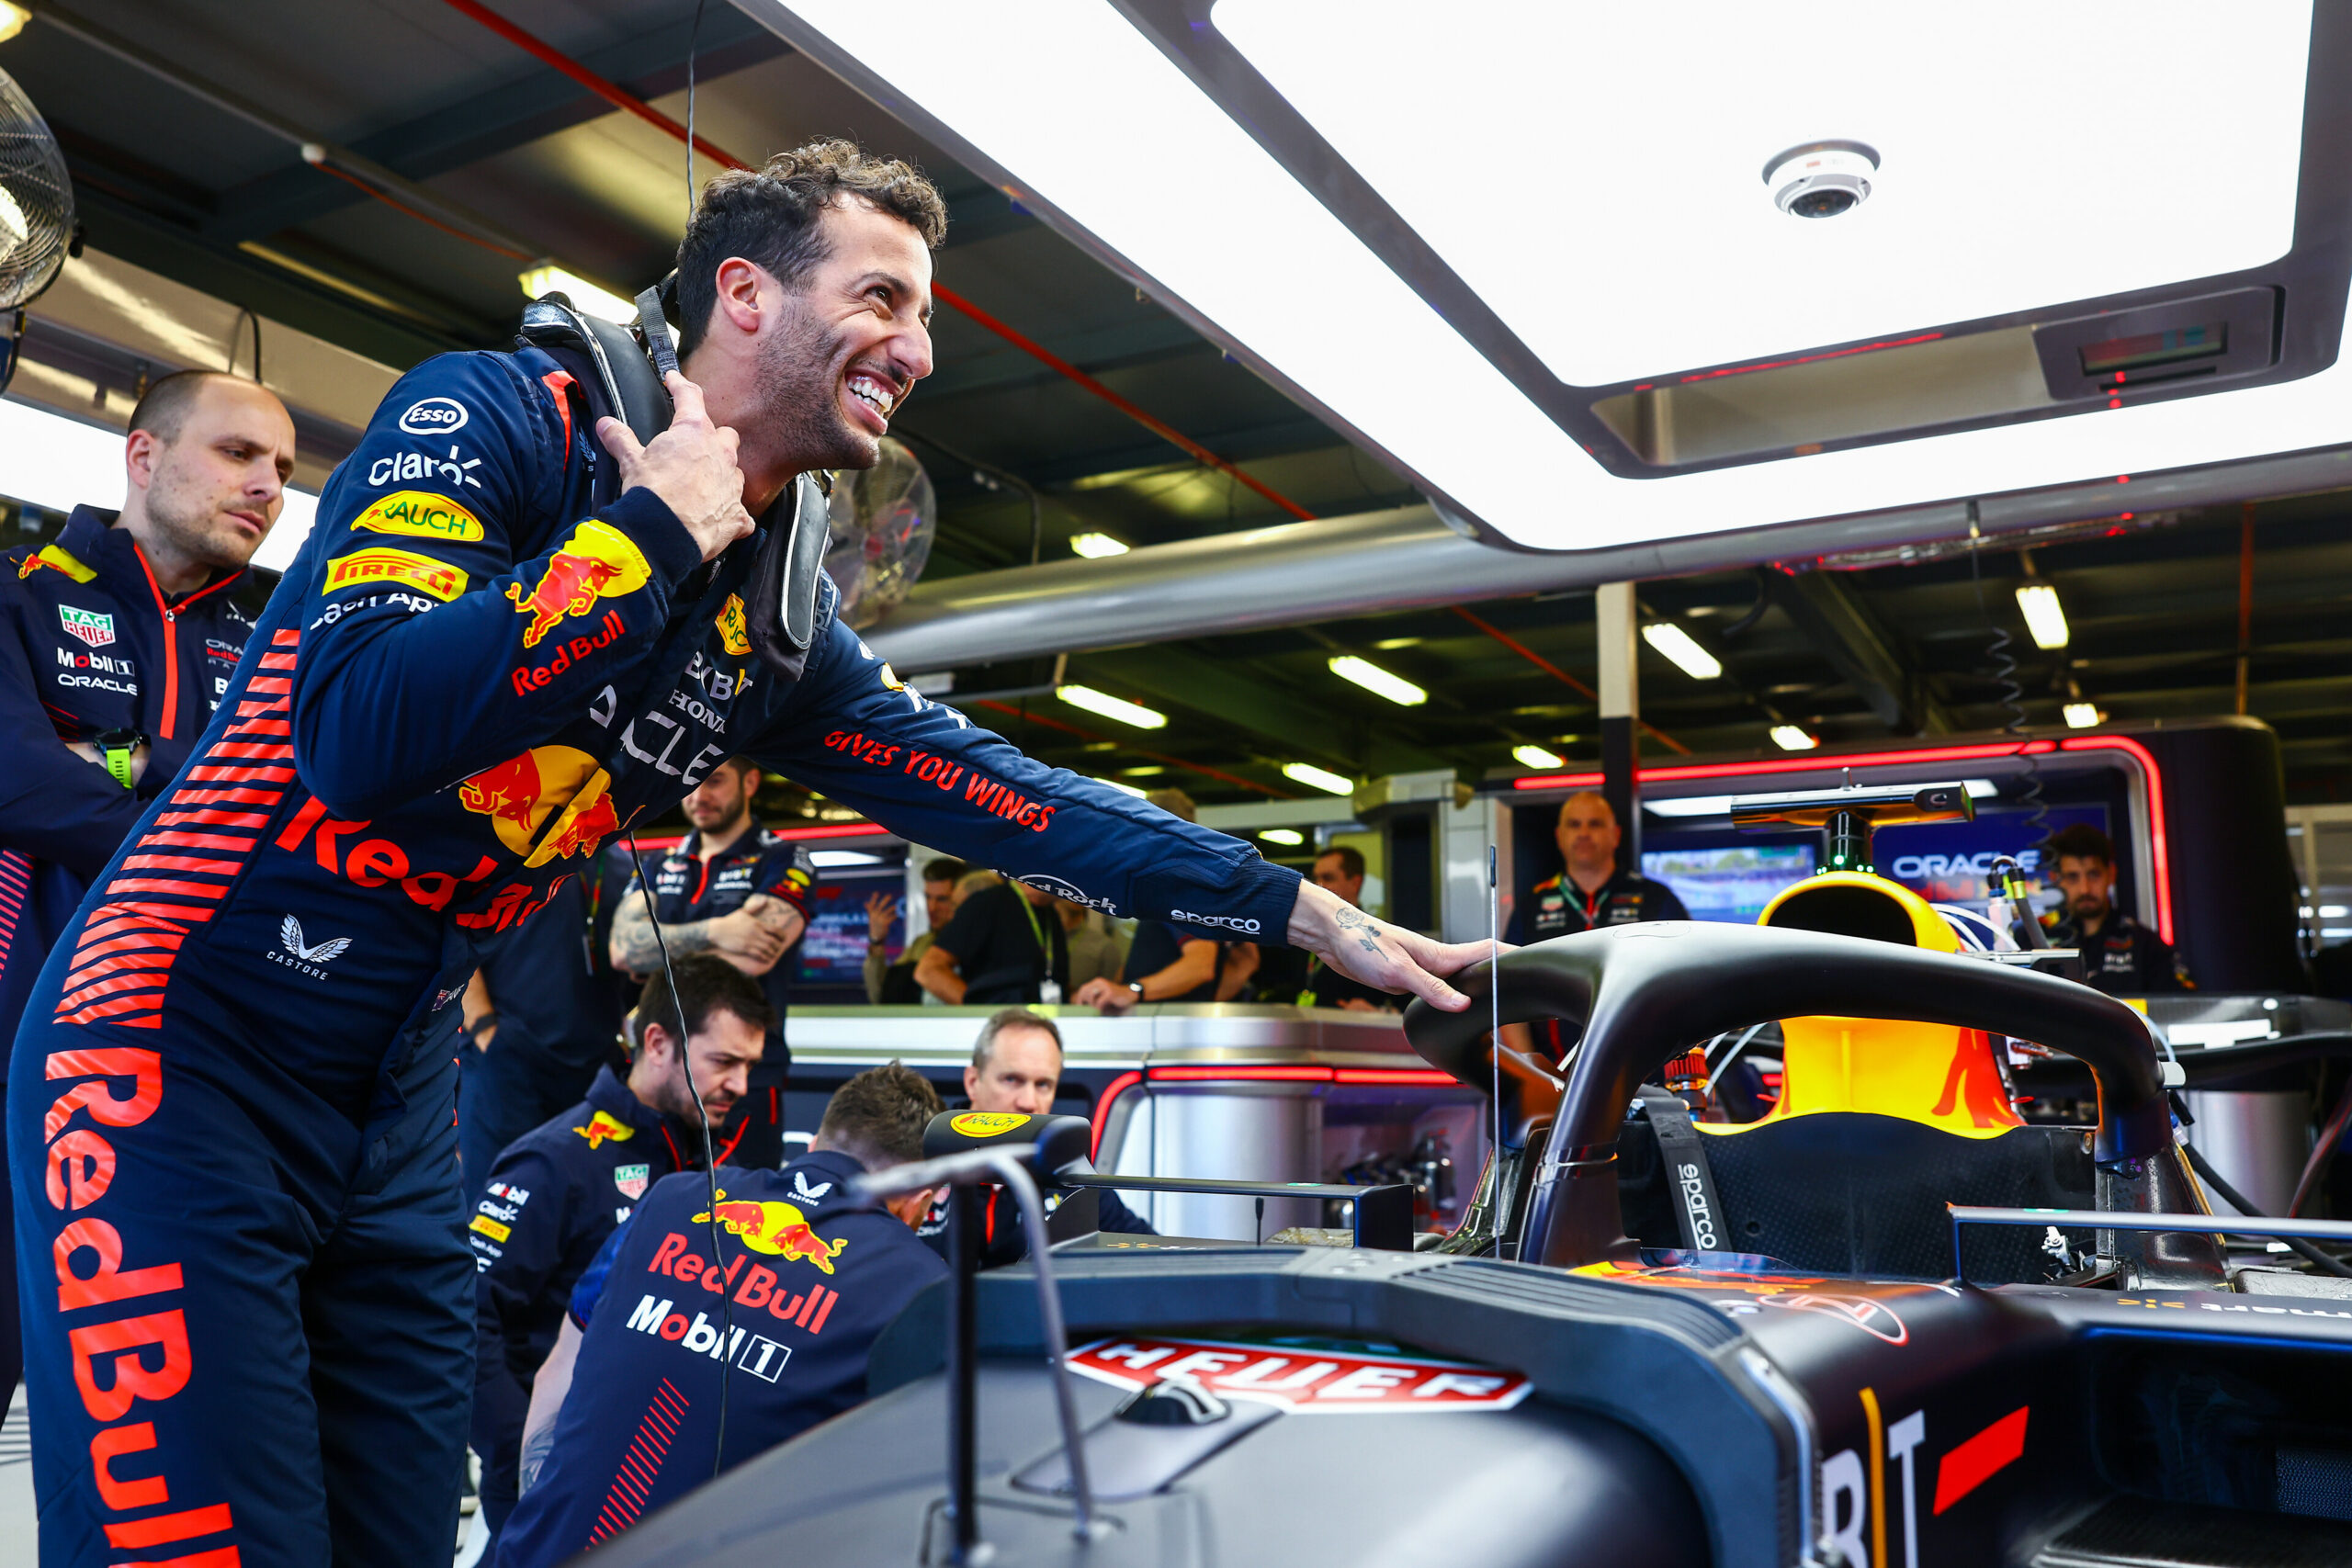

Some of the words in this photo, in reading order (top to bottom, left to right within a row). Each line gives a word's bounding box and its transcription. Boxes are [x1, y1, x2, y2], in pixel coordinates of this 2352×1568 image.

[334, 554, 457, 597] PIRELLI
[62, 609, 109, 631] TAG
[63, 621, 116, 645] HEUER
[57, 647, 114, 673] Mobil
[511, 645, 571, 697] Red
[569, 609, 626, 661] Bull
[57, 673, 138, 696] ORACLE
[823, 730, 901, 767] GIVES
[903, 750, 965, 792] YOU
[964, 773, 1057, 833] WINGS
[1170, 909, 1261, 936] sparco
[266, 950, 329, 981] CASTORE
[45, 1046, 184, 1313] Red
[1677, 1163, 1718, 1251] sparco
[648, 1232, 748, 1294] Red
[733, 1263, 840, 1335] Bull
[626, 1294, 747, 1364] Mobil
